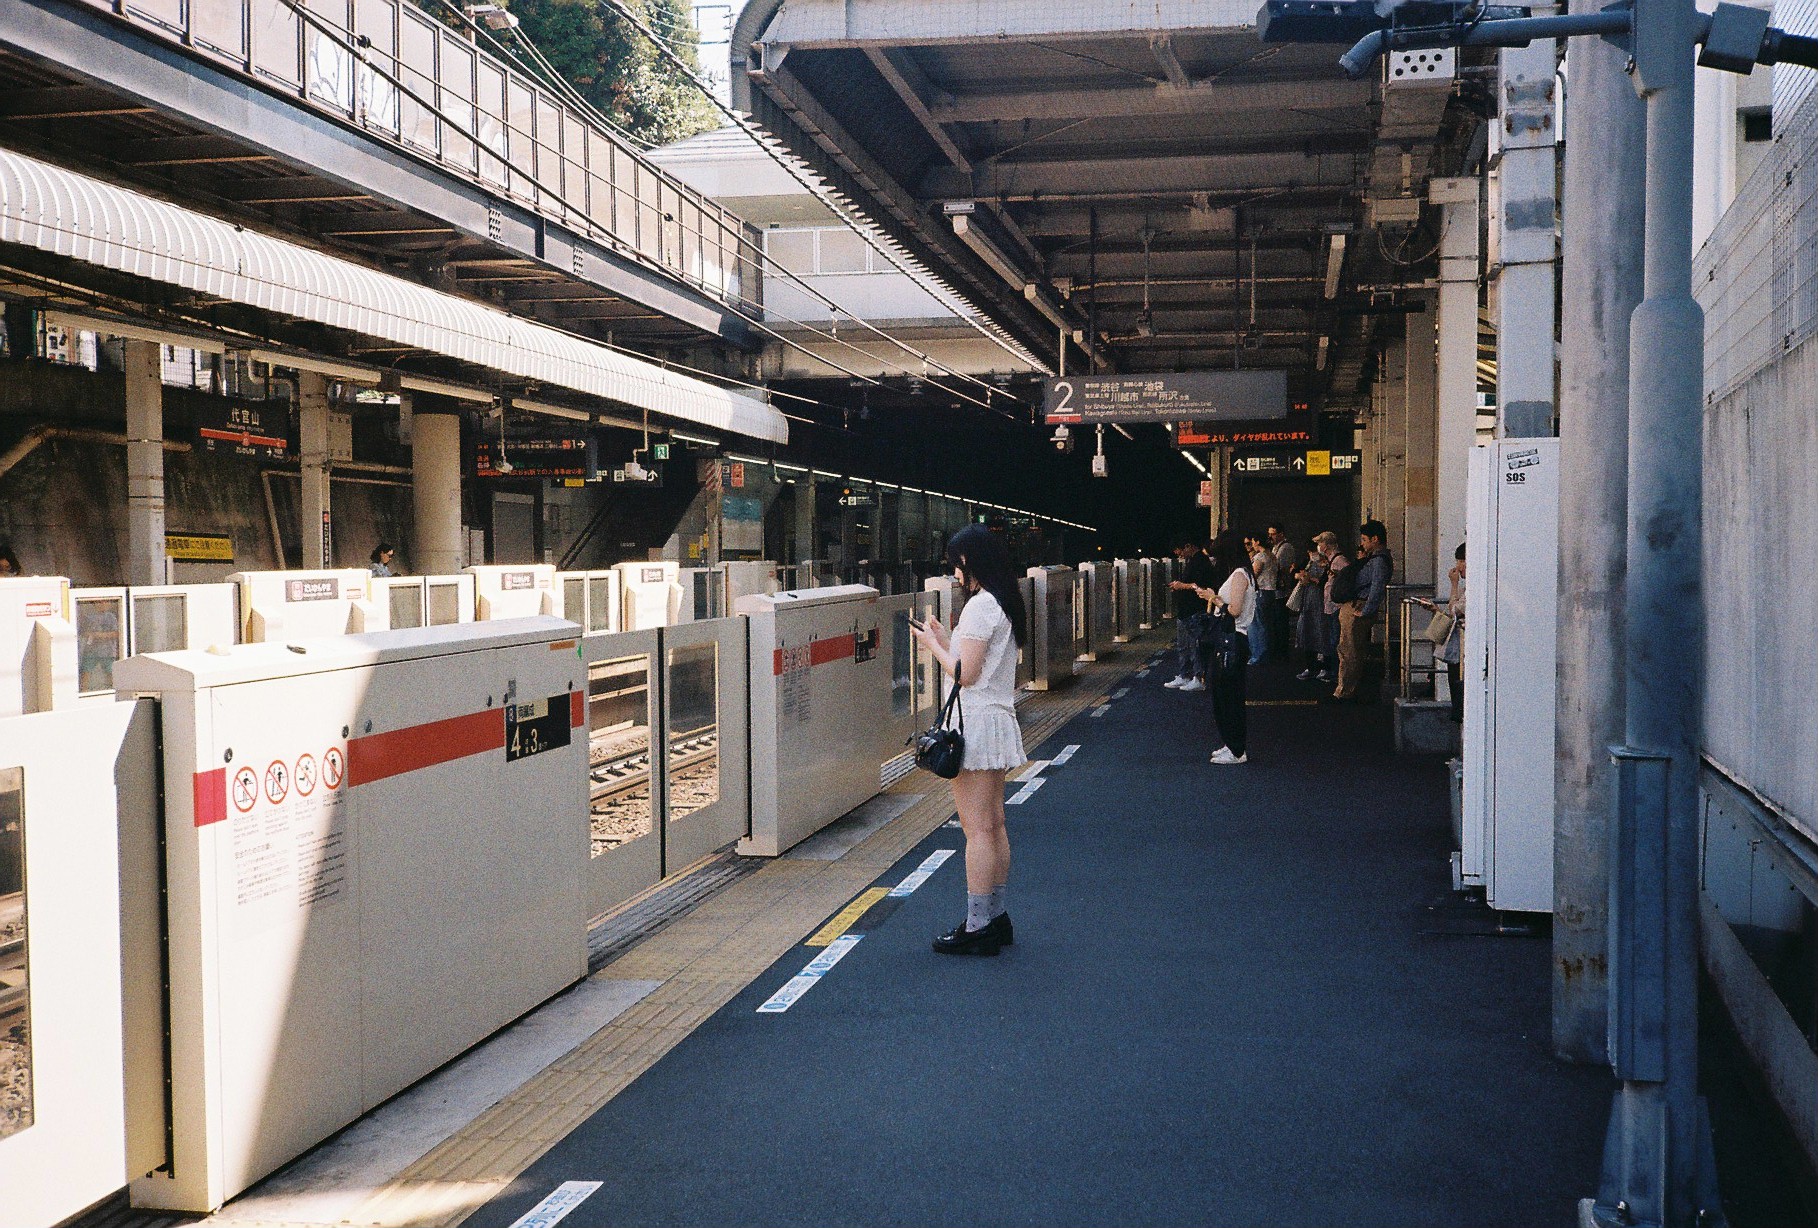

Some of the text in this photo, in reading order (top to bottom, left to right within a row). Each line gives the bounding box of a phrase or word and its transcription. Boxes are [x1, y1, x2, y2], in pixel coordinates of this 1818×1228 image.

[1100, 382, 1120, 392] 渋谷
[1144, 381, 1164, 391] 池袋
[1054, 381, 1074, 413] 2
[1158, 390, 1178, 401] 所沢
[231, 407, 260, 425] 代官山
[1506, 473, 1526, 482] SOS
[510, 724, 522, 758] 4
[531, 728, 538, 753] 3
